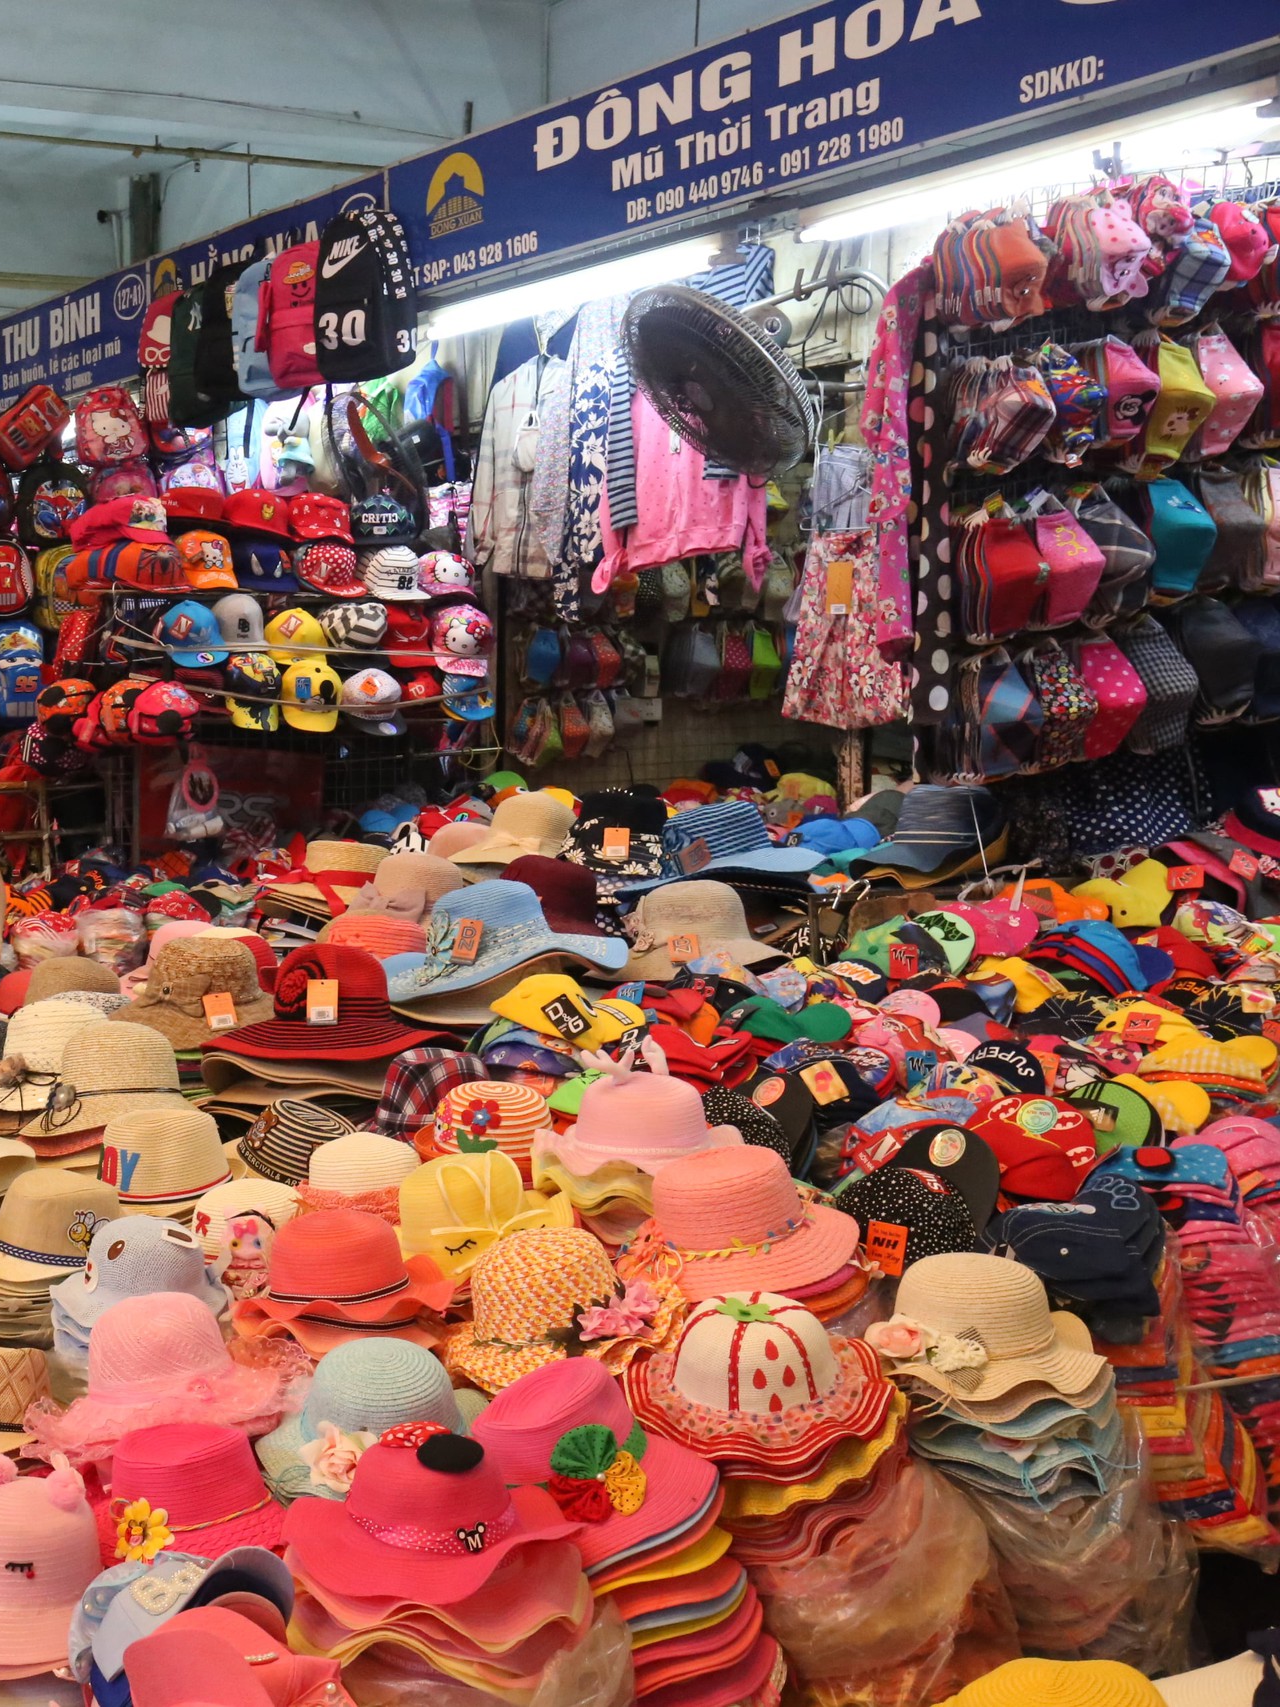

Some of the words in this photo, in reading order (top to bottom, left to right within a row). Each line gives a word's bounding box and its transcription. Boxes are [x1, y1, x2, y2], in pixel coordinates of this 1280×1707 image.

[533, 51, 751, 171] ĐÔNG
[778, 0, 982, 88] HOA
[1019, 55, 1104, 103] SDKKD:
[612, 145, 664, 191] Mũ
[675, 115, 751, 170] Thời
[765, 77, 880, 141] Trang
[626, 197, 651, 223] DĐ:
[656, 186, 684, 214] 090
[689, 175, 718, 204] 440
[721, 161, 763, 195] 9746
[780, 147, 810, 178] 091
[818, 133, 851, 166] 228
[857, 117, 904, 153] 1980
[330, 235, 360, 261] NIKE
[453, 250, 476, 275] 043
[479, 241, 502, 267] 928
[506, 231, 538, 259] 1606
[2, 316, 41, 365] THU
[319, 309, 367, 350] 30
[544, 1001, 585, 1034] D&G
[872, 1236, 899, 1250] NH
[466, 1533, 483, 1551] M
